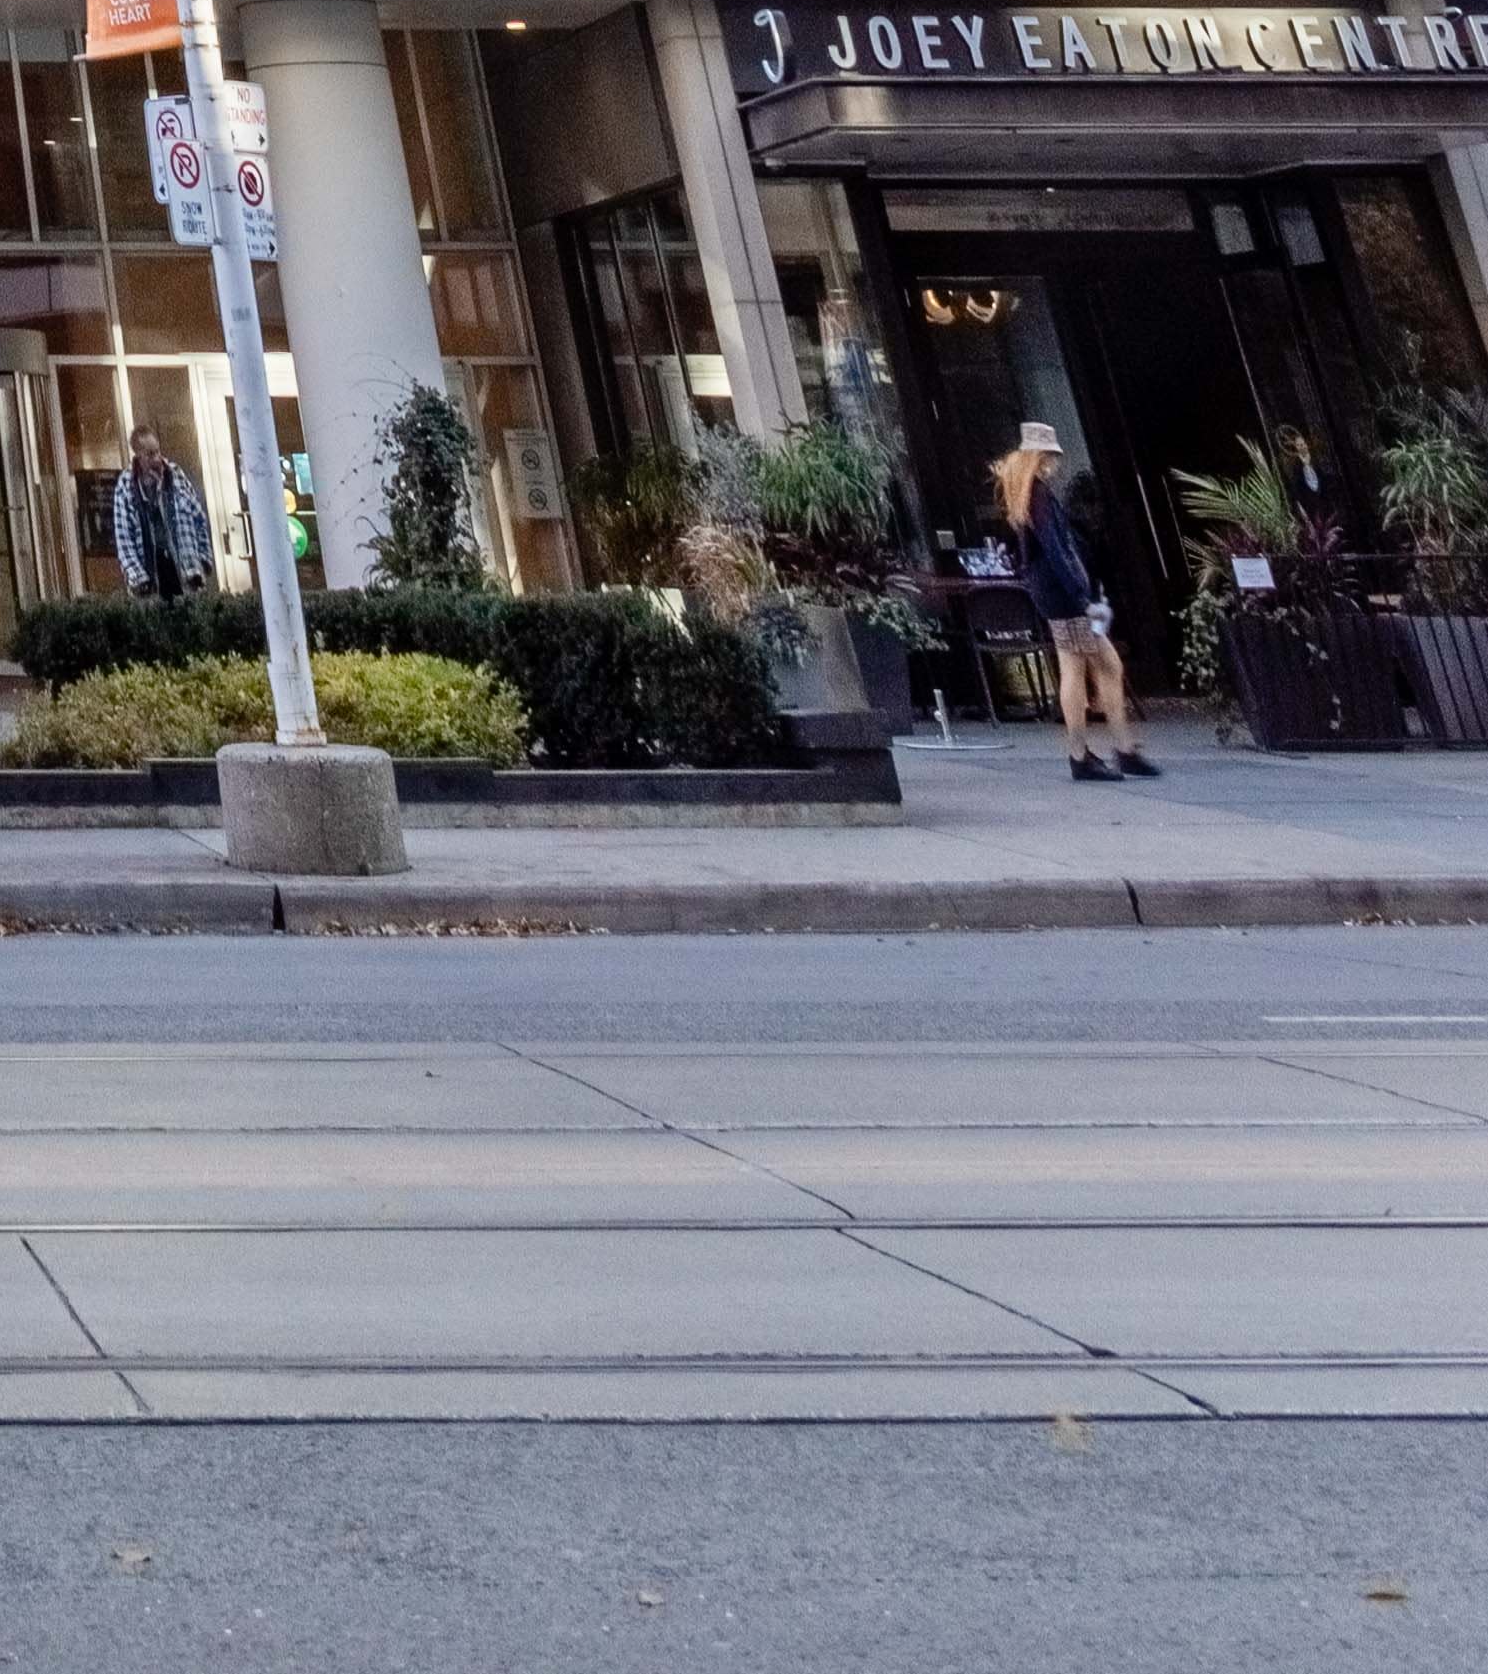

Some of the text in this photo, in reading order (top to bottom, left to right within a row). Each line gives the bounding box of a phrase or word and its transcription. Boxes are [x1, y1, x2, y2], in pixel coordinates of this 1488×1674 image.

[109, 4, 153, 26] HEART
[828, 15, 1488, 71] JOEY EATON CENTRE
[237, 88, 251, 104] NO
[181, 201, 203, 215] SNOW
[182, 219, 207, 235] ROUTE
